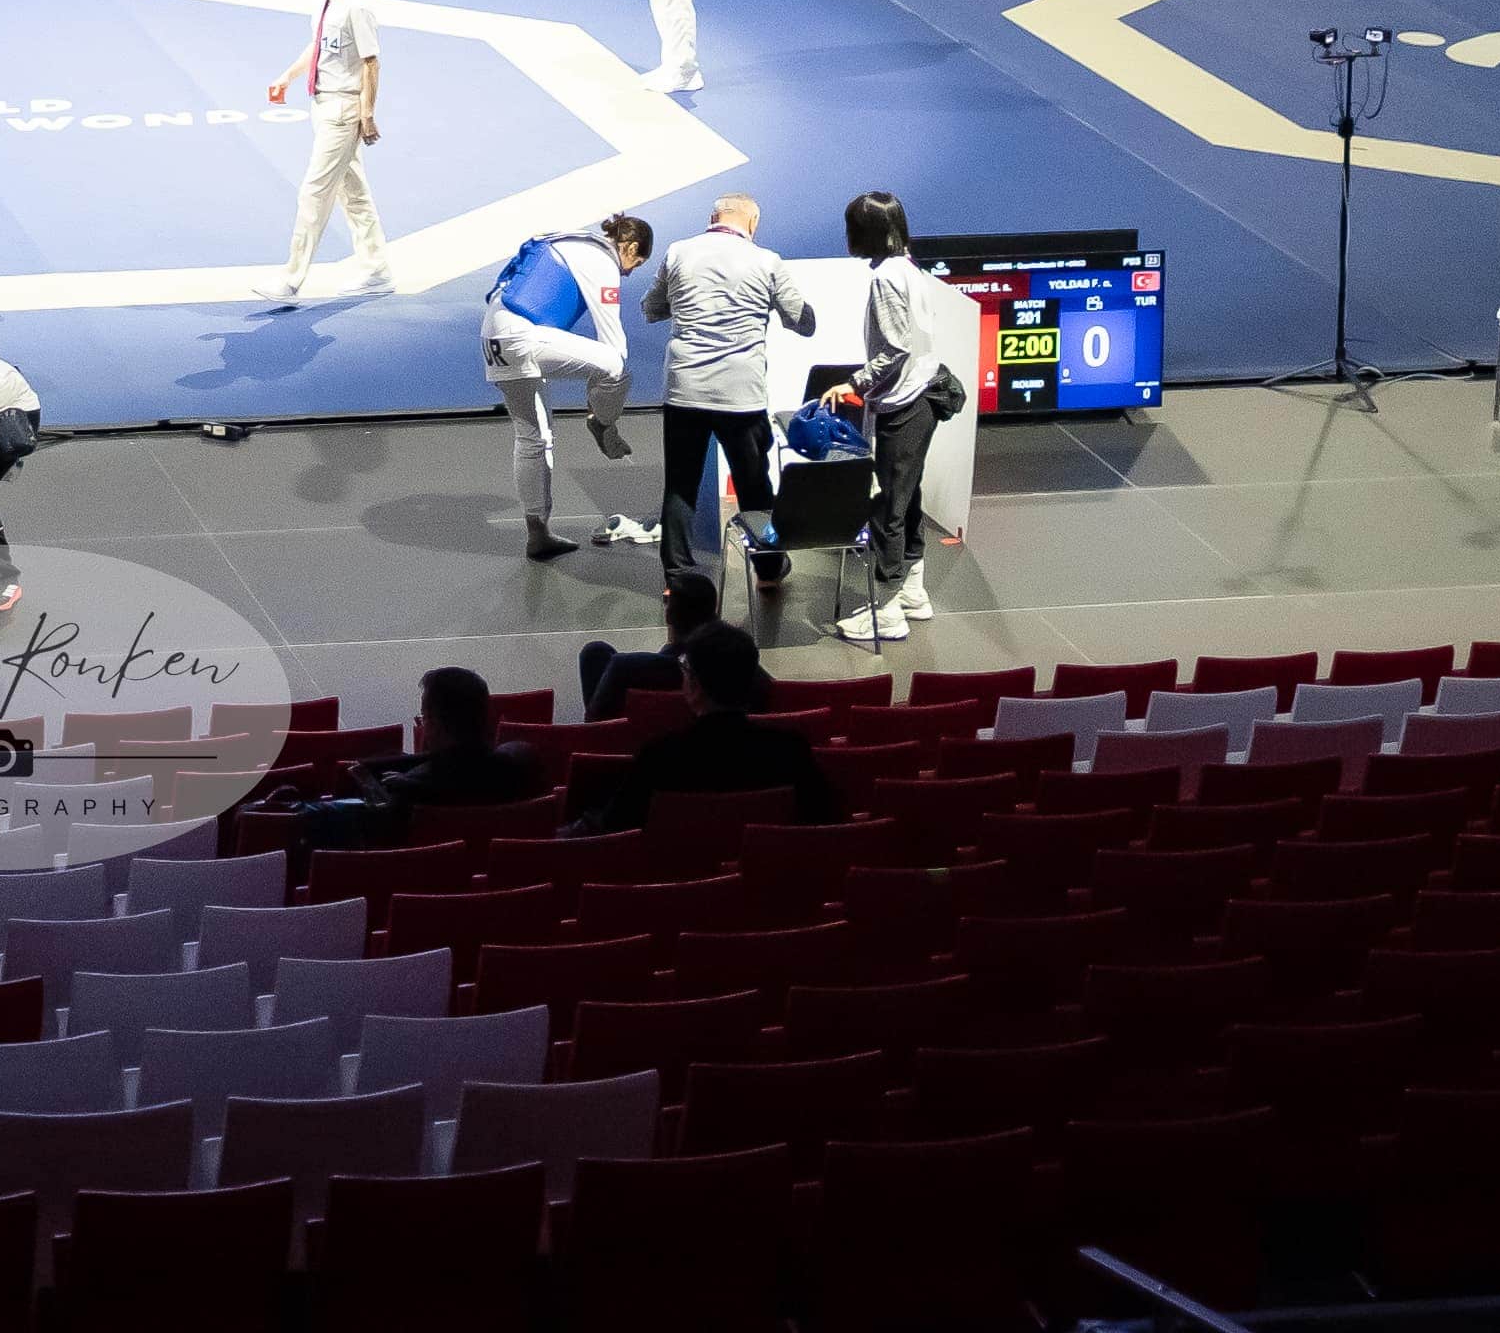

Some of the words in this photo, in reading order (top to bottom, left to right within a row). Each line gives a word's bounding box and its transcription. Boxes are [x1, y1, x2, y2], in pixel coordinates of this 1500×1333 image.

[321, 37, 341, 49] 14
[1014, 299, 1045, 309] MATCH
[1135, 296, 1157, 307] TUR
[1016, 311, 1041, 325] 201
[481, 338, 509, 367] UR
[1003, 336, 1053, 358] 2:00
[1082, 325, 1110, 368] 0
[1012, 379, 1045, 389] ROUND
[1023, 391, 1031, 402] 1
[1142, 387, 1150, 399] 0
